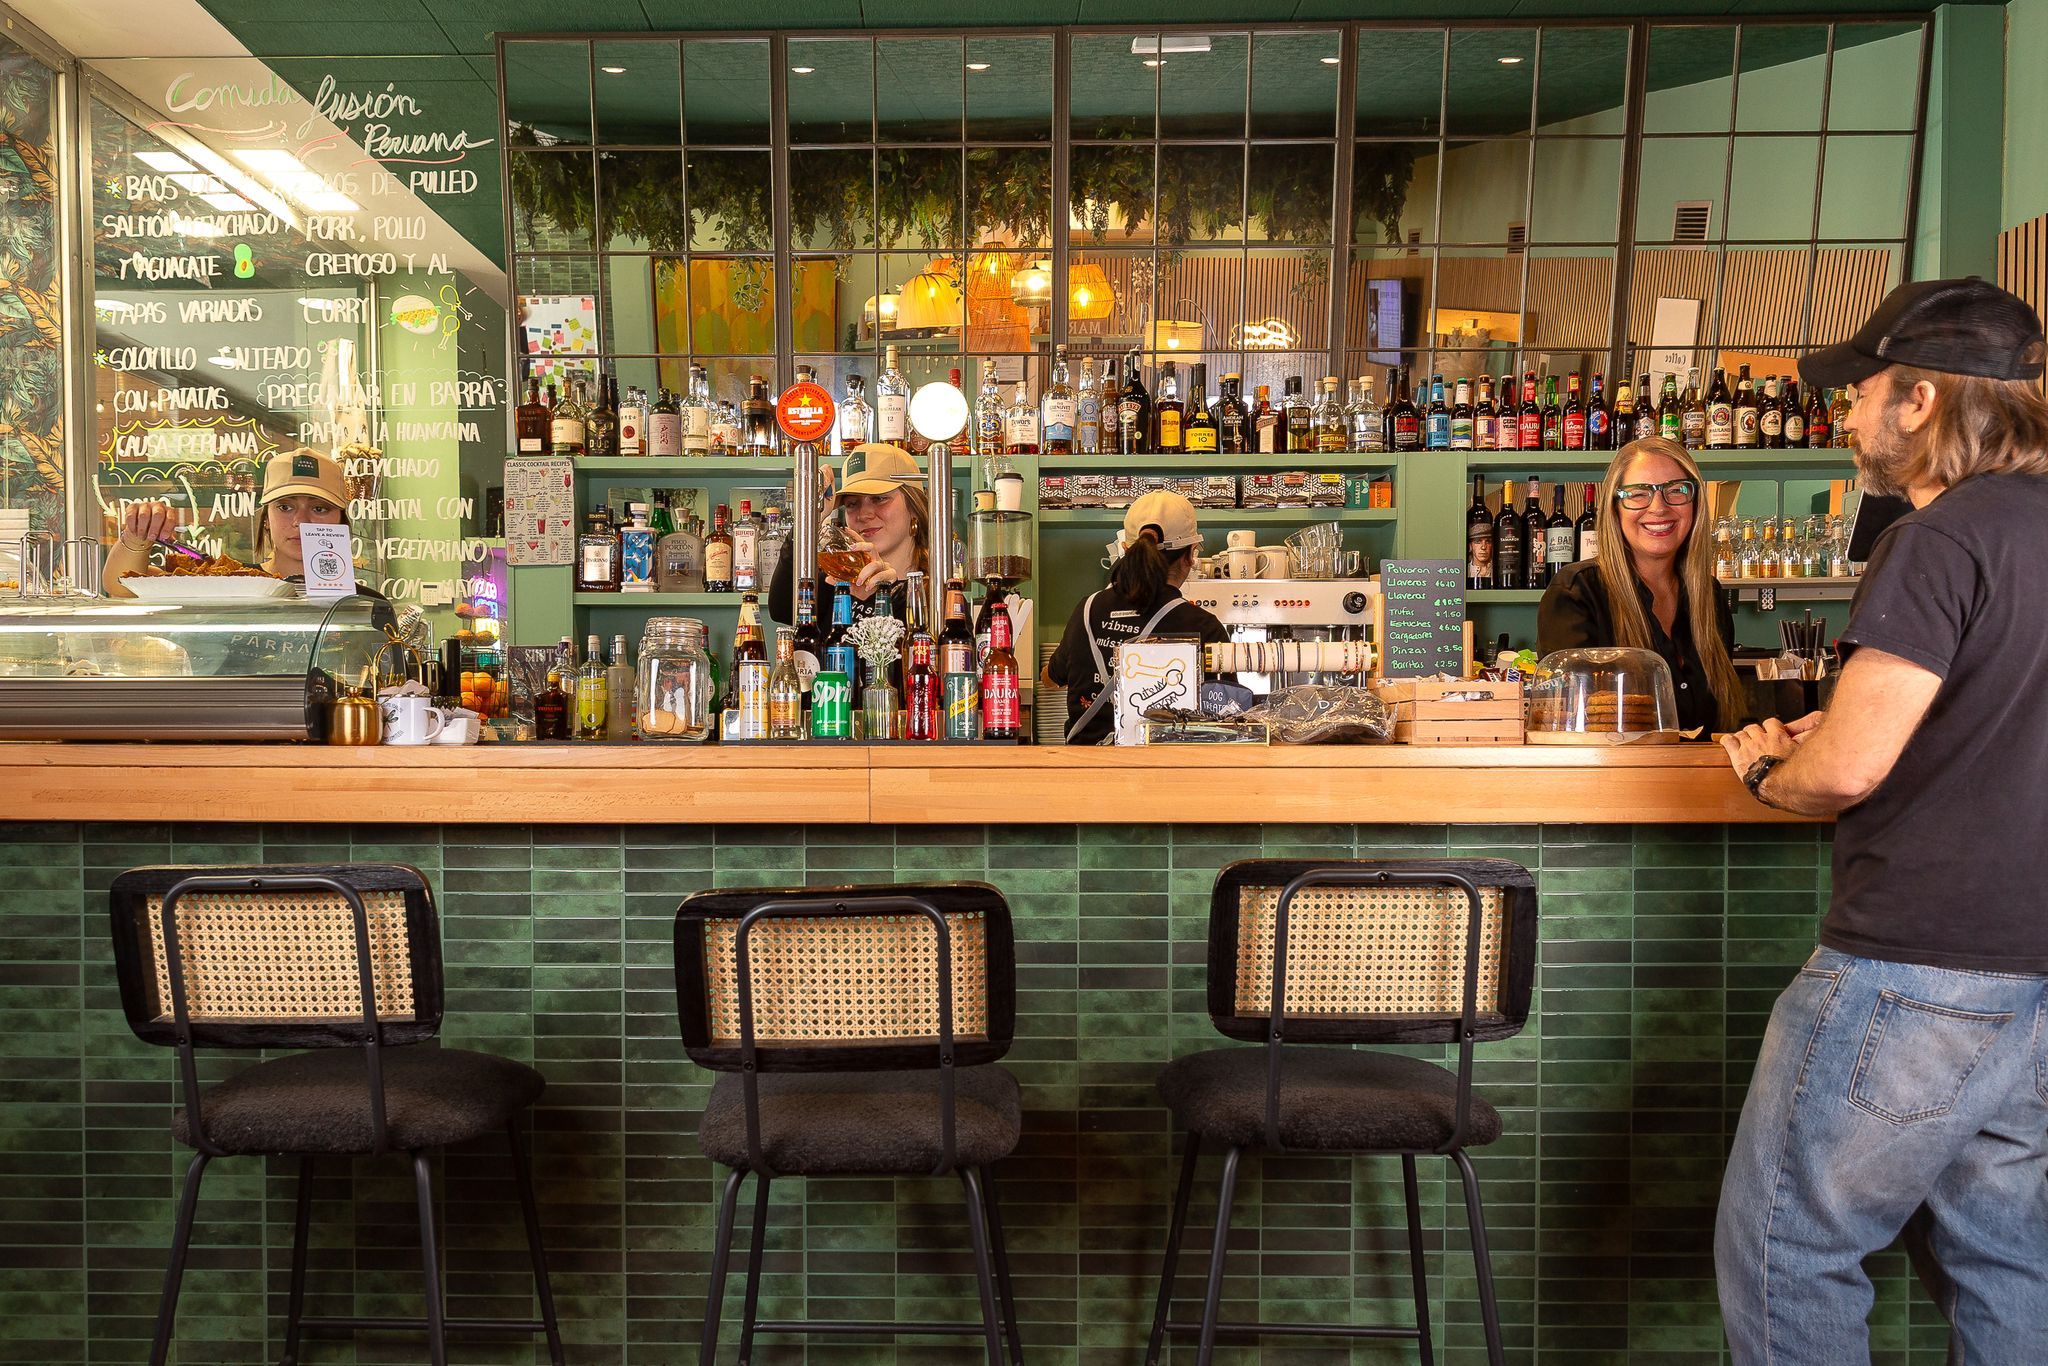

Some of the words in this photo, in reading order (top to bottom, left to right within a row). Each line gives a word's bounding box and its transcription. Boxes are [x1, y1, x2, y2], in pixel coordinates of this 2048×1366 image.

[166, 72, 302, 114] Comida
[297, 74, 422, 139] fusión
[364, 123, 494, 157] Peruana
[126, 175, 179, 201] BAOS
[371, 172, 401, 196] DE
[409, 169, 478, 195] PULLED
[373, 216, 427, 241] POLLO
[119, 257, 133, 281] Y
[137, 256, 223, 281] AGUACATE
[305, 252, 397, 276] CREMOSO
[402, 254, 417, 275] Y
[427, 253, 453, 275] AL
[109, 302, 167, 326] TAPAS
[179, 298, 263, 324] VARIADAS
[302, 297, 371, 326] CURRY
[107, 346, 198, 372] SOLOMILLO
[219, 346, 312, 372] SALTEADO
[113, 389, 149, 413] CON
[391, 382, 417, 406] EN
[115, 434, 169, 458] CAUSA
[177, 431, 260, 456] PERUANA
[344, 457, 441, 479] ACEVICHADO
[208, 484, 257, 523] ATÚN
[347, 496, 428, 521] ORIENTAL
[436, 496, 474, 520] CON
[375, 537, 488, 563] VEGETARIANO
[1386, 563, 1431, 574] Polvoron
[379, 576, 420, 600] CON
[1387, 577, 1428, 587] Llaveros
[1387, 592, 1427, 600] Llaveros
[1389, 607, 1415, 617] Trufas
[1389, 620, 1432, 628] Estuches
[1101, 620, 1141, 635] vibras
[1391, 645, 1427, 655] Pinzas
[1391, 660, 1425, 670] Barritas
[984, 688, 1018, 699] DAURA
[1208, 690, 1224, 702] DOG
